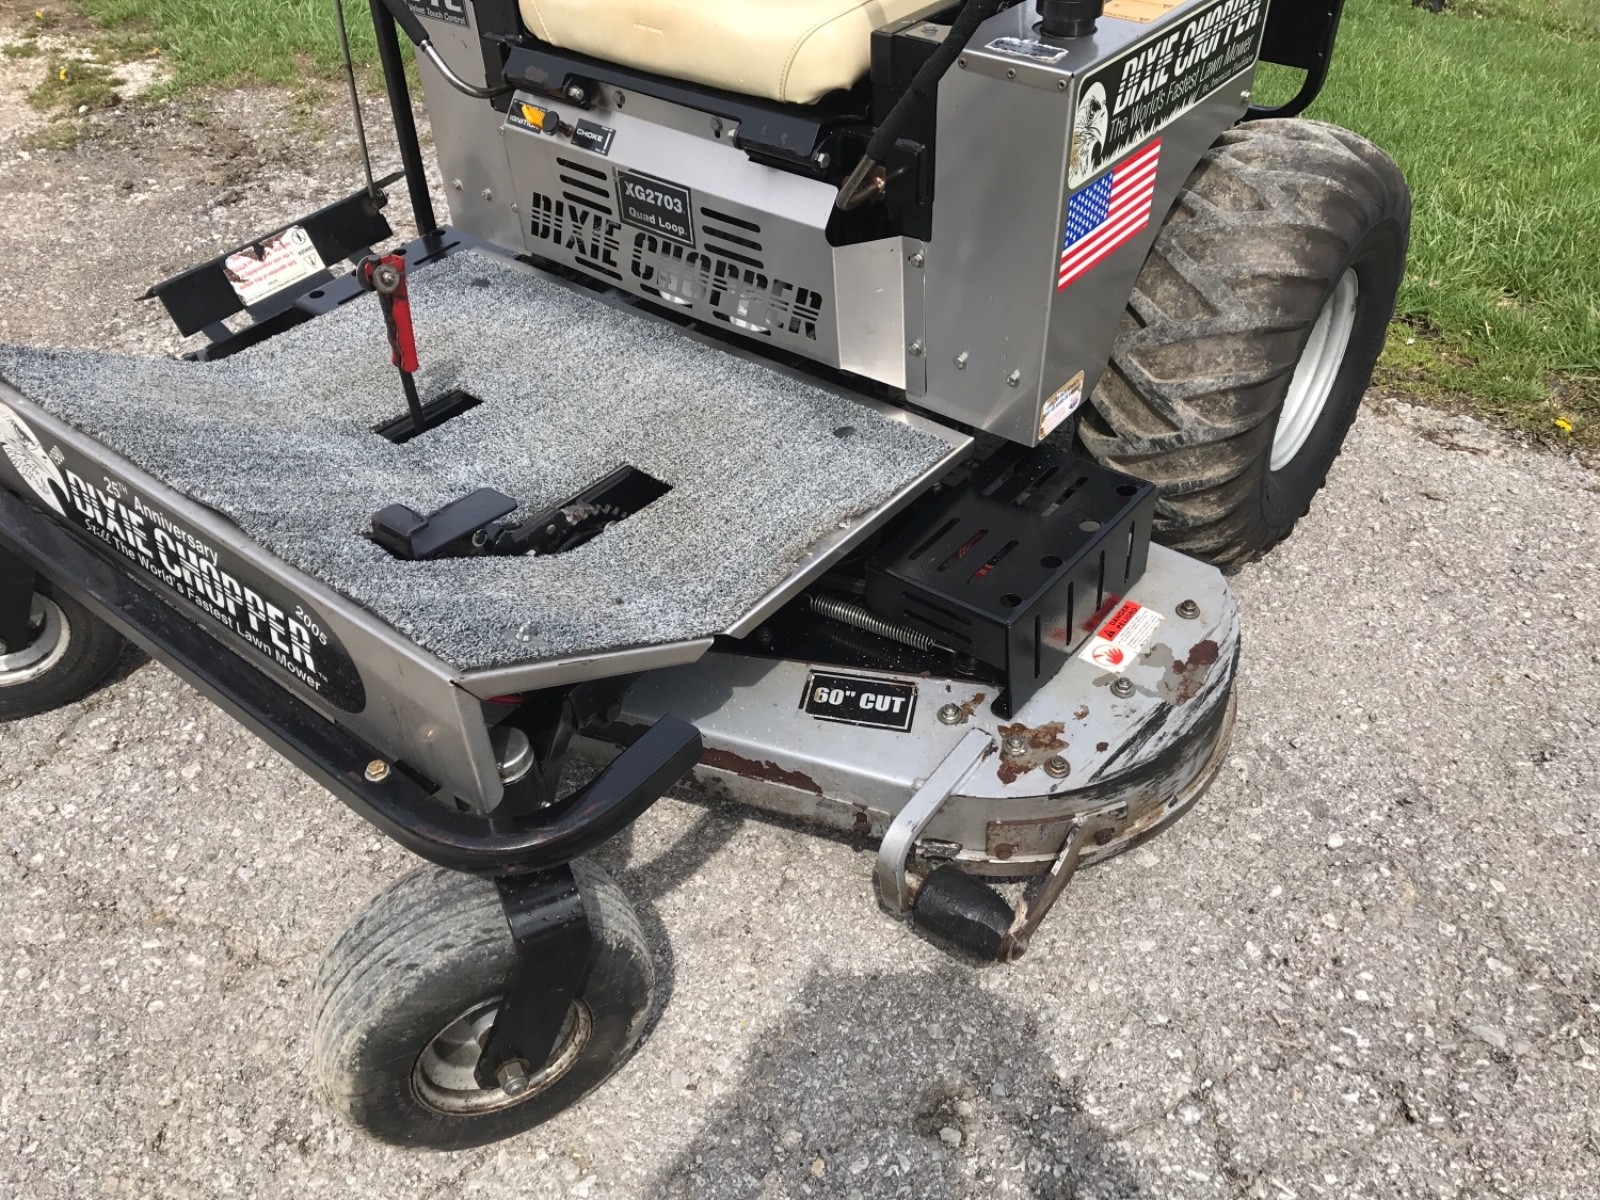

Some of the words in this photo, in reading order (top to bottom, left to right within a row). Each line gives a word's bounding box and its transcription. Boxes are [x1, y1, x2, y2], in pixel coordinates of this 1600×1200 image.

[426, 7, 444, 19] Touch
[444, 12, 467, 25] Control
[1109, 116, 1129, 142] The
[1130, 89, 1166, 129] World's
[1166, 65, 1201, 105] Fastest
[1200, 53, 1224, 83] Lawn
[1223, 33, 1255, 67] Mower
[1113, 30, 1181, 116] DIXIE
[1173, 0, 1261, 77] CHOPPER
[576, 128, 603, 142] CHOKE
[628, 206, 656, 225] Quad
[530, 191, 622, 268] DIXIE
[630, 231, 823, 341] CHOPPER
[134, 495, 218, 567] Anniversary
[65, 468, 154, 560] DIXIE
[154, 527, 318, 674] CHOPPER
[84, 518, 112, 545] Still
[112, 535, 136, 561] The
[137, 552, 185, 594] World's
[187, 584, 234, 629] Fastest
[236, 621, 272, 656] Lawn
[275, 648, 321, 691] Mower
[294, 604, 328, 646] 2005
[813, 686, 857, 706] 60"
[859, 692, 906, 713] CUT
